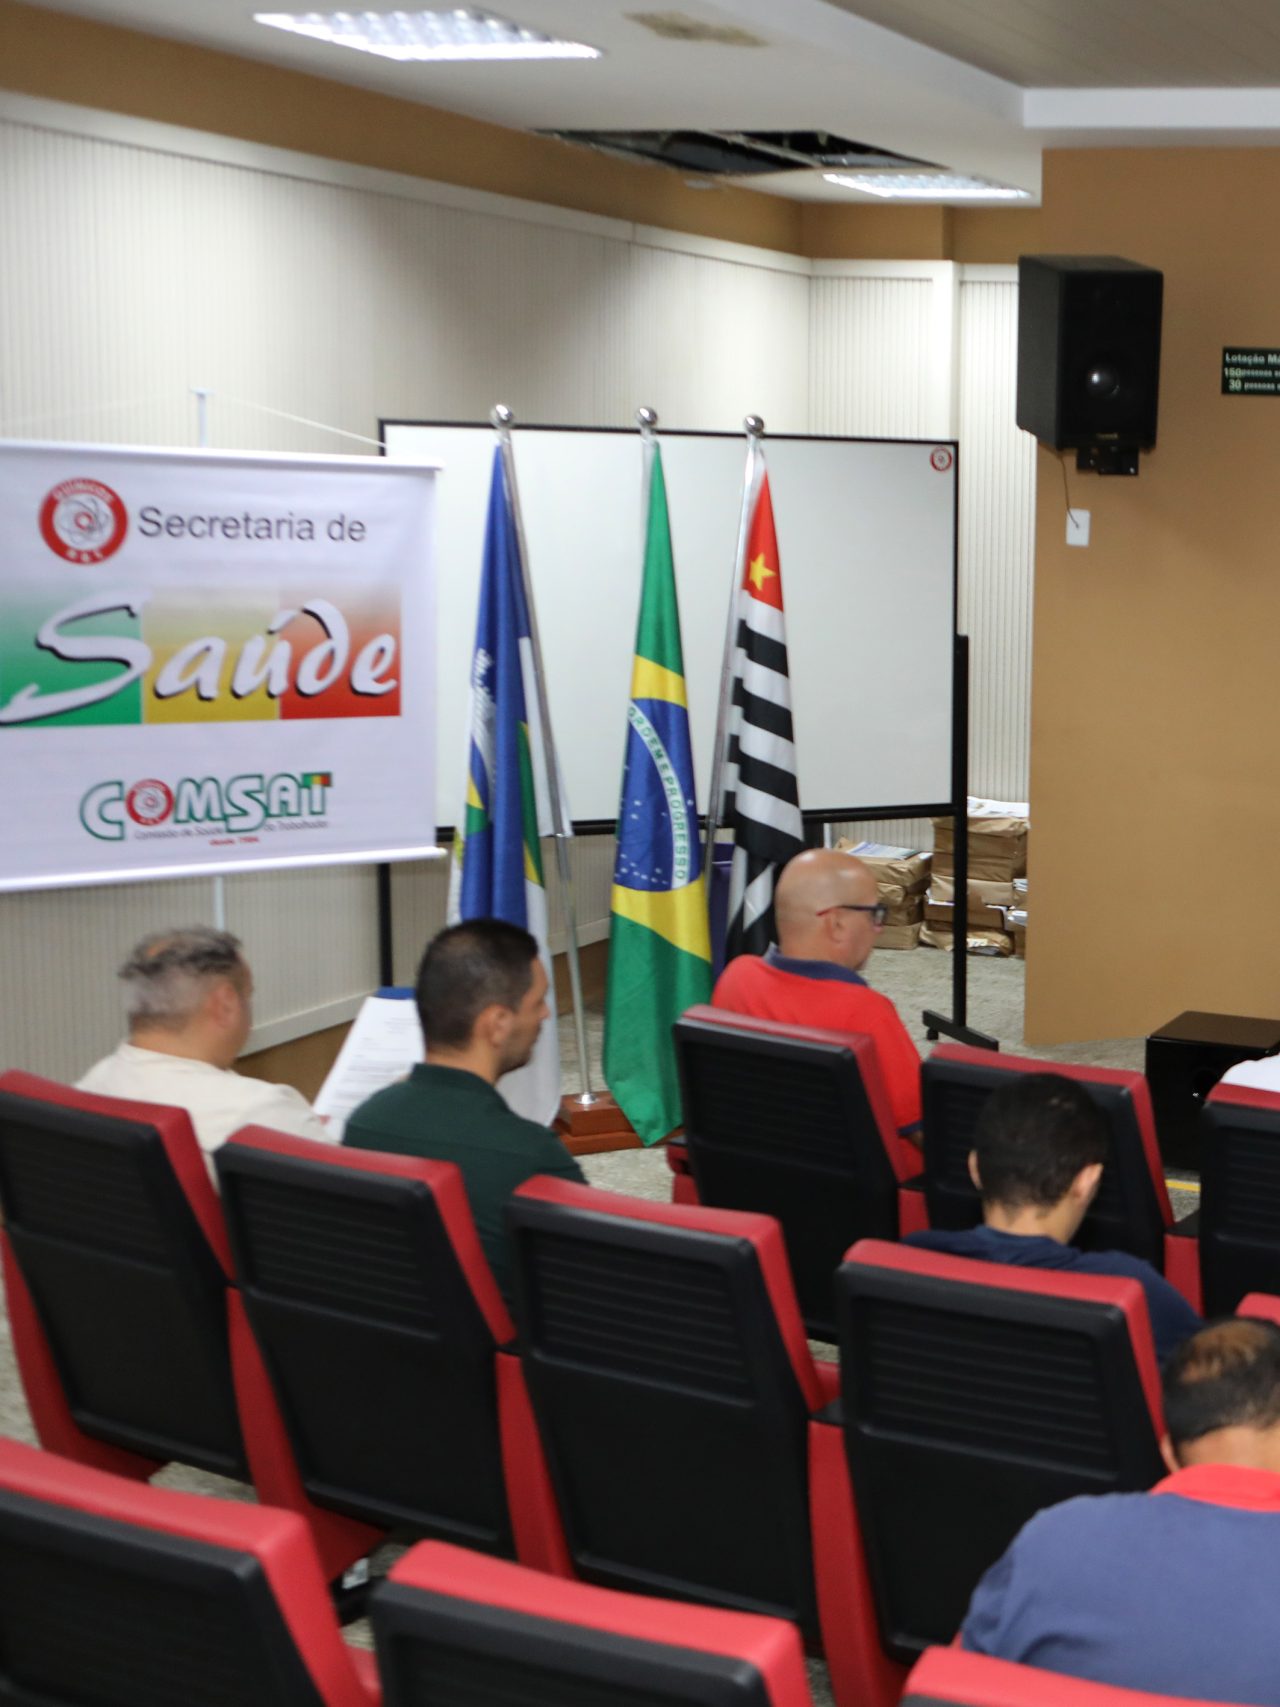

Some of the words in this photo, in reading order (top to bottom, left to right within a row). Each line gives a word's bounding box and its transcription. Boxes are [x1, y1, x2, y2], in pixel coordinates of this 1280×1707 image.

[1225, 352, 1265, 366] Lotação
[1229, 379, 1242, 391] 30
[138, 507, 315, 542] Secretaria
[327, 514, 367, 542] de
[0, 589, 398, 727] Saúde
[80, 771, 334, 841] COMSAT
[664, 776, 688, 881] PROGRESSO
